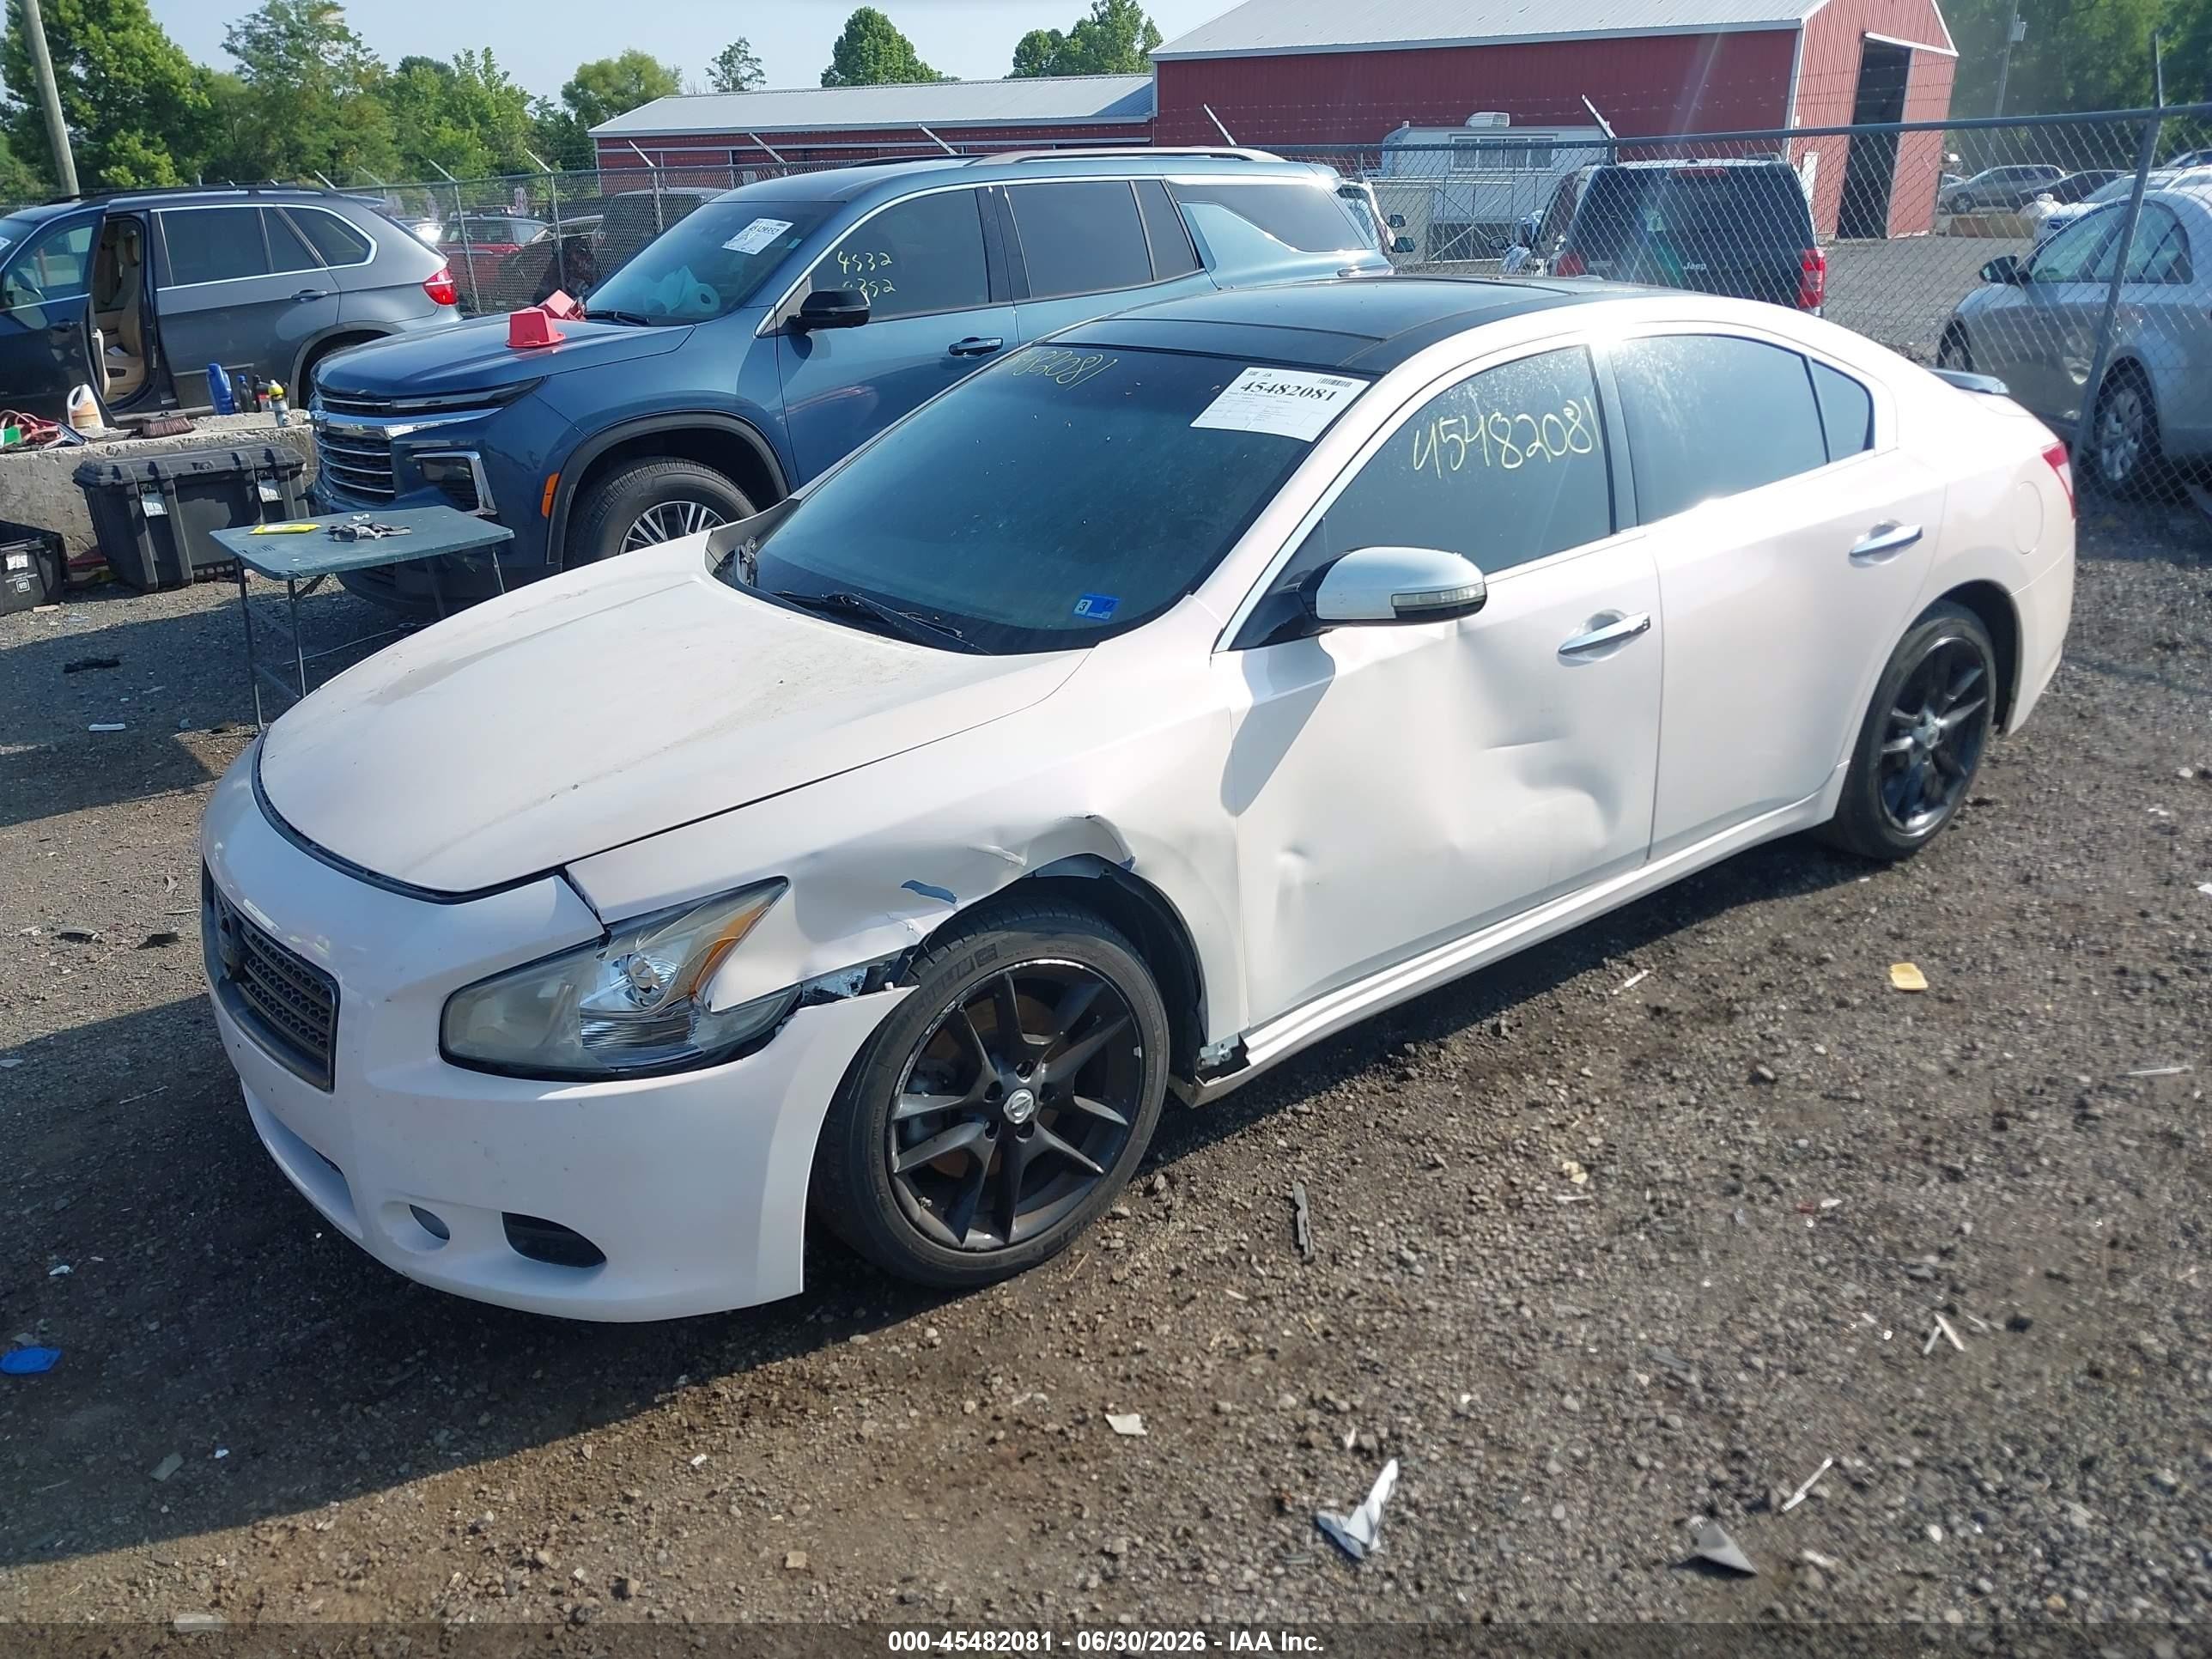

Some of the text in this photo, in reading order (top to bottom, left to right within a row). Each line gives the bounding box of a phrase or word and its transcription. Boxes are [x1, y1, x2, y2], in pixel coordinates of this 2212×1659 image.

[837, 251, 893, 274] 4532
[1683, 261, 1707, 270] Jeep
[842, 277, 896, 298] 352
[1240, 380, 1338, 401] 45482081
[1413, 396, 1601, 479] 45482081
[1079, 601, 1088, 611] 3
